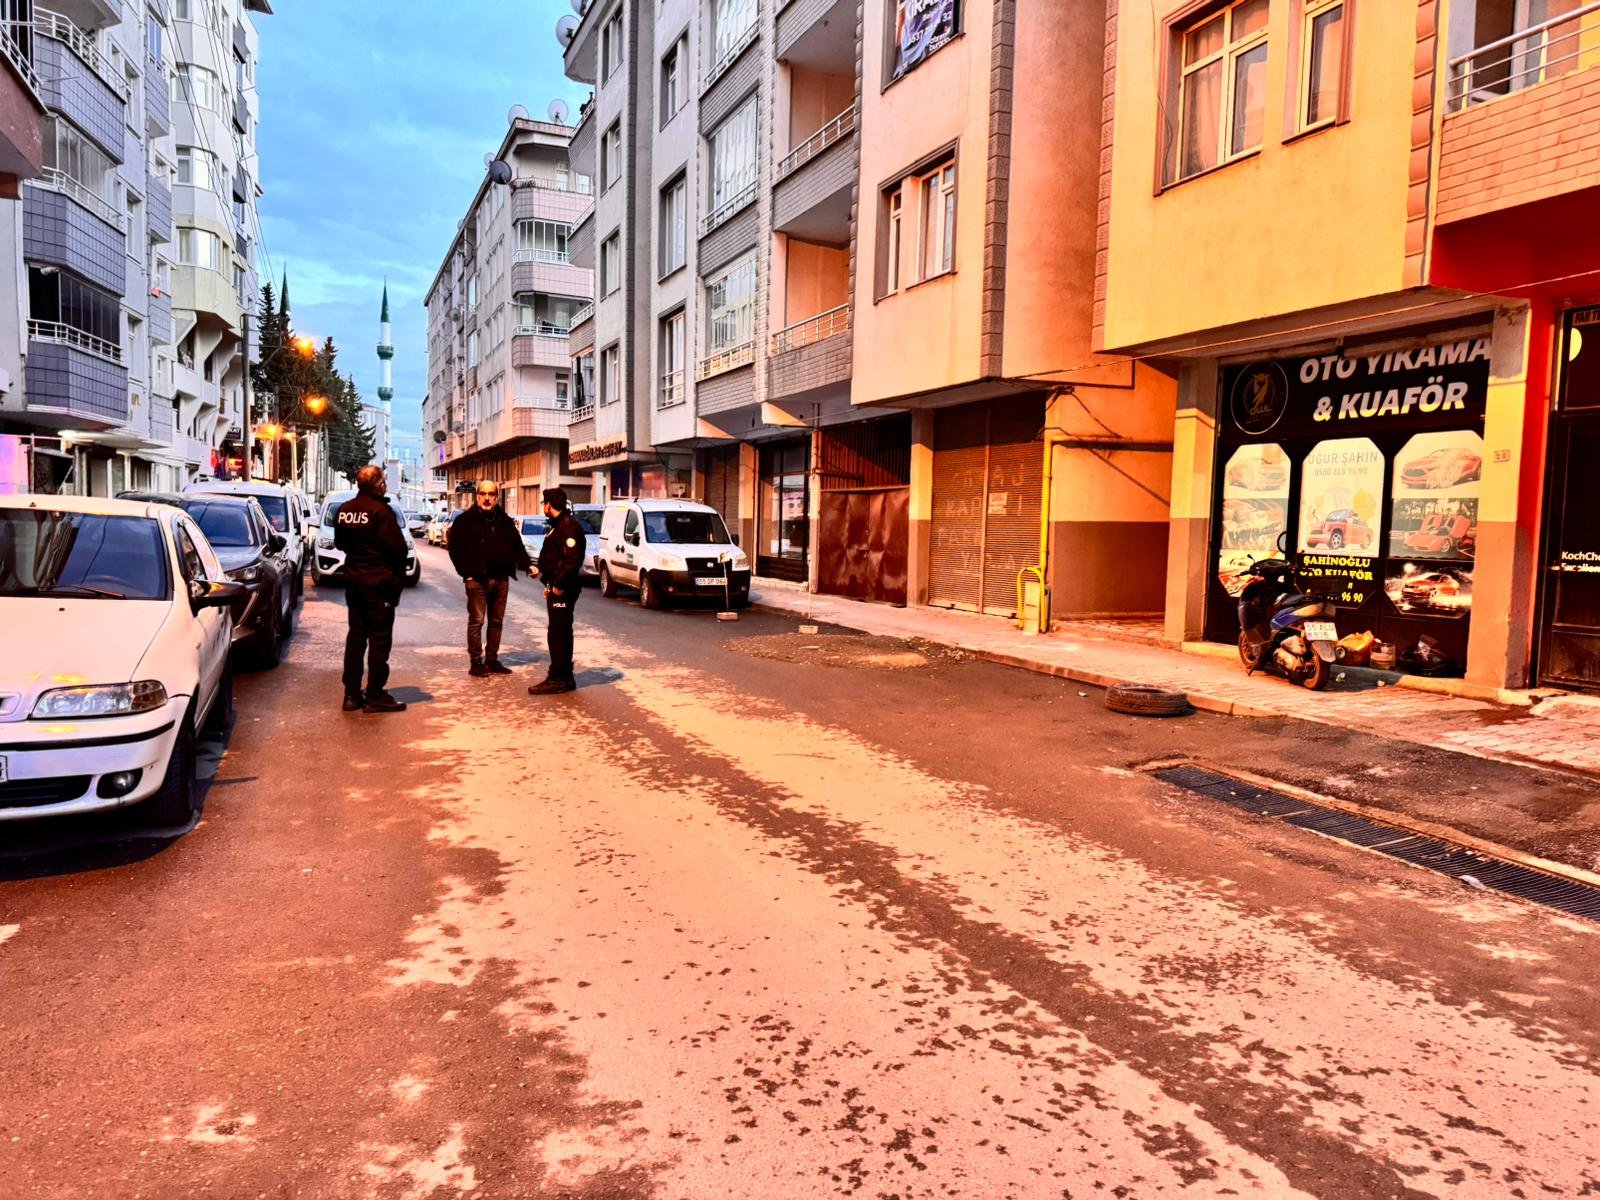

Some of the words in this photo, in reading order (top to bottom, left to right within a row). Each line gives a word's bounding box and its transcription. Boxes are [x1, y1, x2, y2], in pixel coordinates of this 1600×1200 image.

[1300, 354, 1358, 384] OTO
[1367, 338, 1491, 375] YIKAMA
[1312, 396, 1334, 422] &
[1338, 375, 1469, 420] KUAFÖR
[1303, 555, 1371, 568] ŞAHİNOĞLU
[1341, 592, 1352, 602] 96
[1353, 593, 1364, 603] 90
